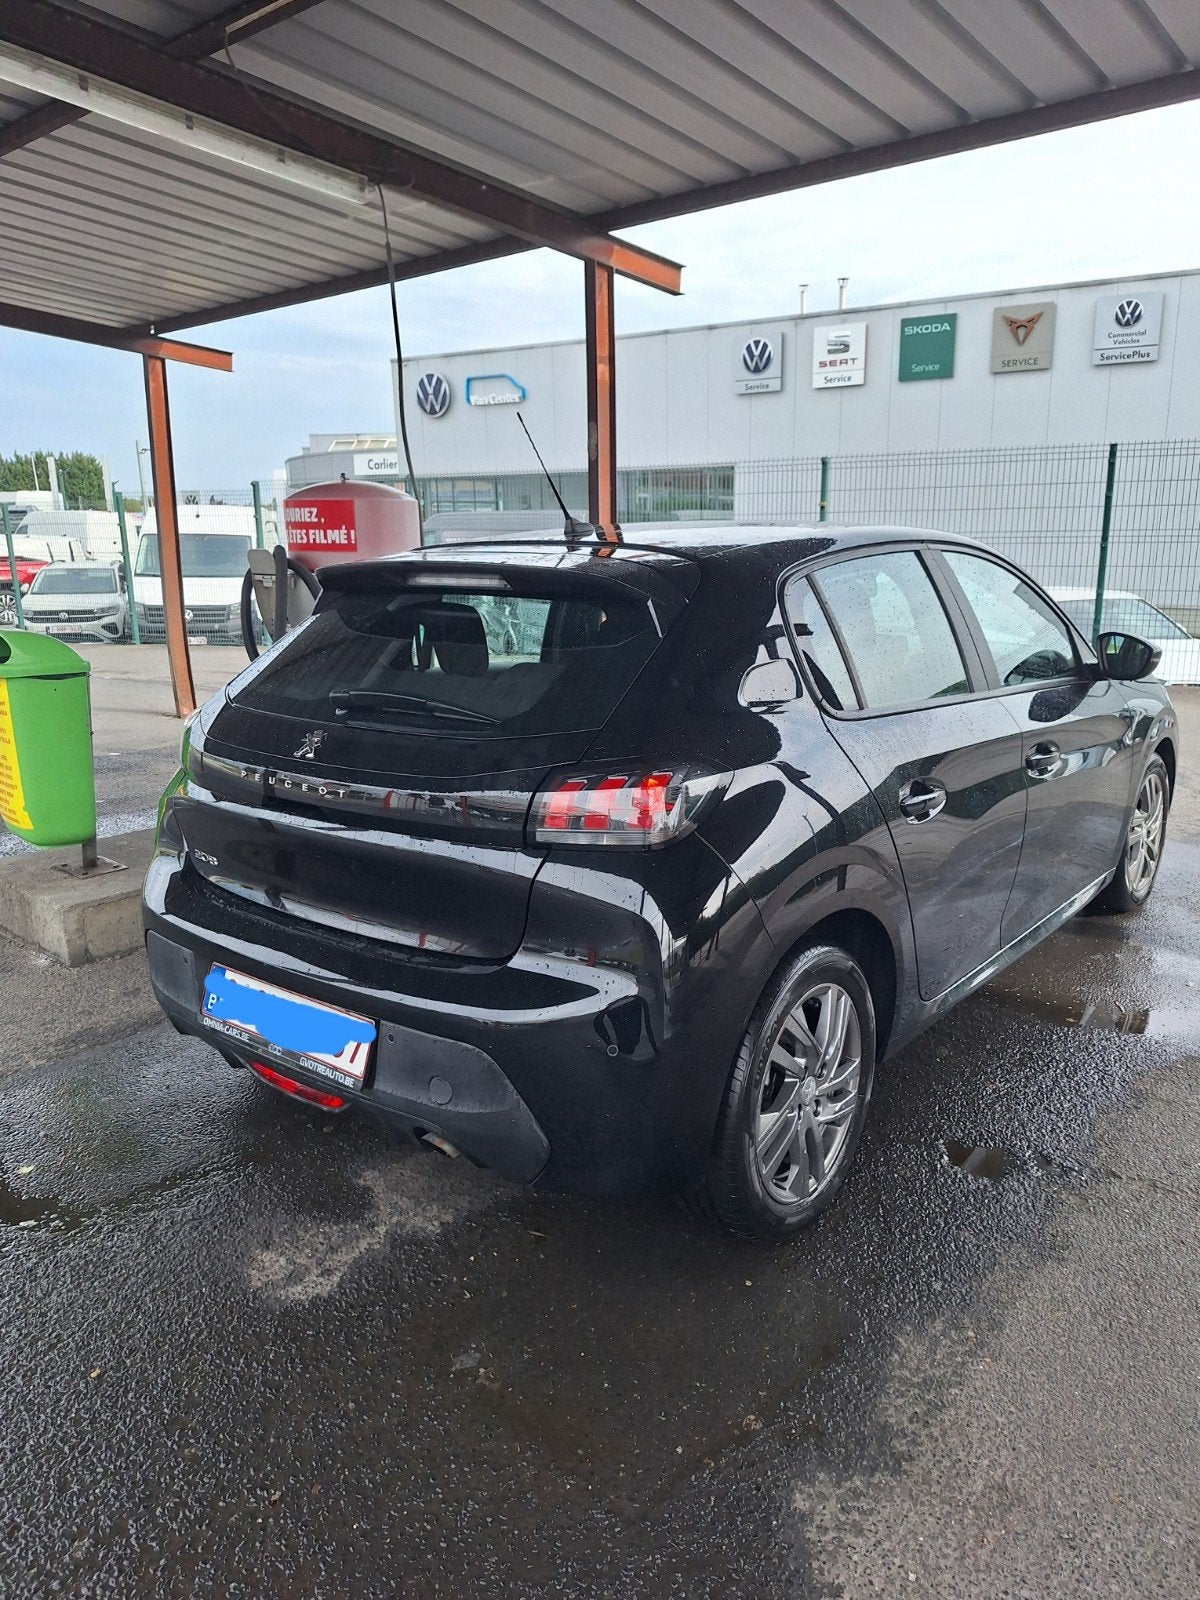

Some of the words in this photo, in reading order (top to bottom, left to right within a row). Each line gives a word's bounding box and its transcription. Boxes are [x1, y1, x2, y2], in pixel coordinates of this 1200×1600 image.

[1107, 329, 1147, 339] Commercial
[1100, 349, 1151, 361] ServicePlus
[818, 357, 858, 368] SEAT
[1002, 357, 1039, 367] SERVICE
[911, 363, 940, 373] Service
[824, 374, 852, 384] Service
[745, 382, 770, 391] Service
[367, 458, 397, 471] Carlier
[285, 507, 318, 523] OURIEZ
[309, 525, 348, 544] FILMÉ
[241, 770, 346, 798] PEUGEOT
[194, 849, 219, 866] 208
